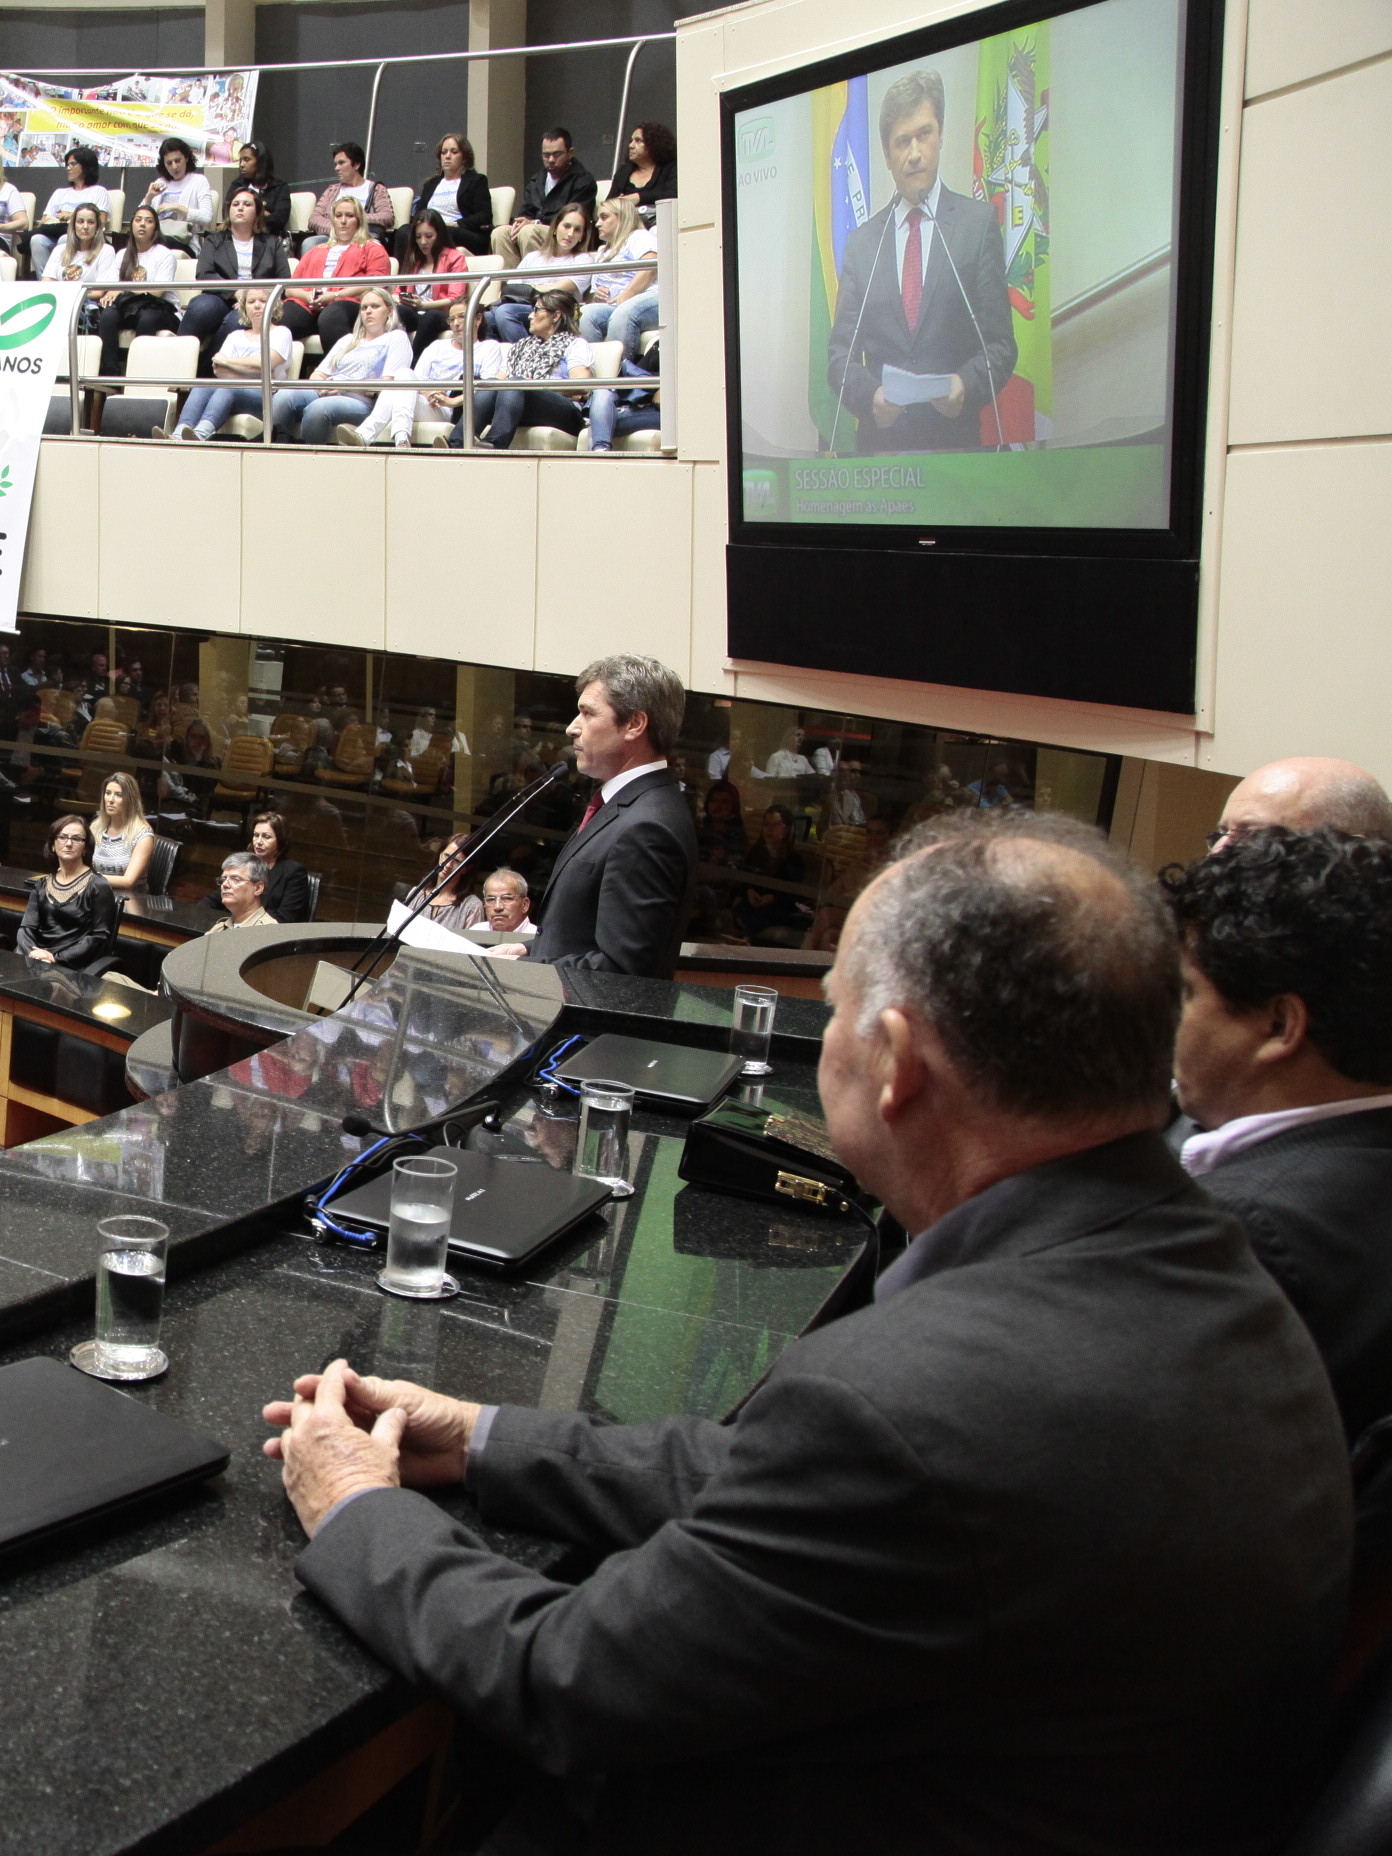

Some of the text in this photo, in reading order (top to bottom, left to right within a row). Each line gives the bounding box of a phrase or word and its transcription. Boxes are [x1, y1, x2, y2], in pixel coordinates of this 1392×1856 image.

[86, 121, 112, 129] amor
[113, 120, 132, 129] com
[753, 165, 778, 183] VIVO
[795, 465, 926, 490] SESSÃO ESPECIAL
[796, 499, 863, 517] Homenagem
[880, 499, 915, 517] Apaes
